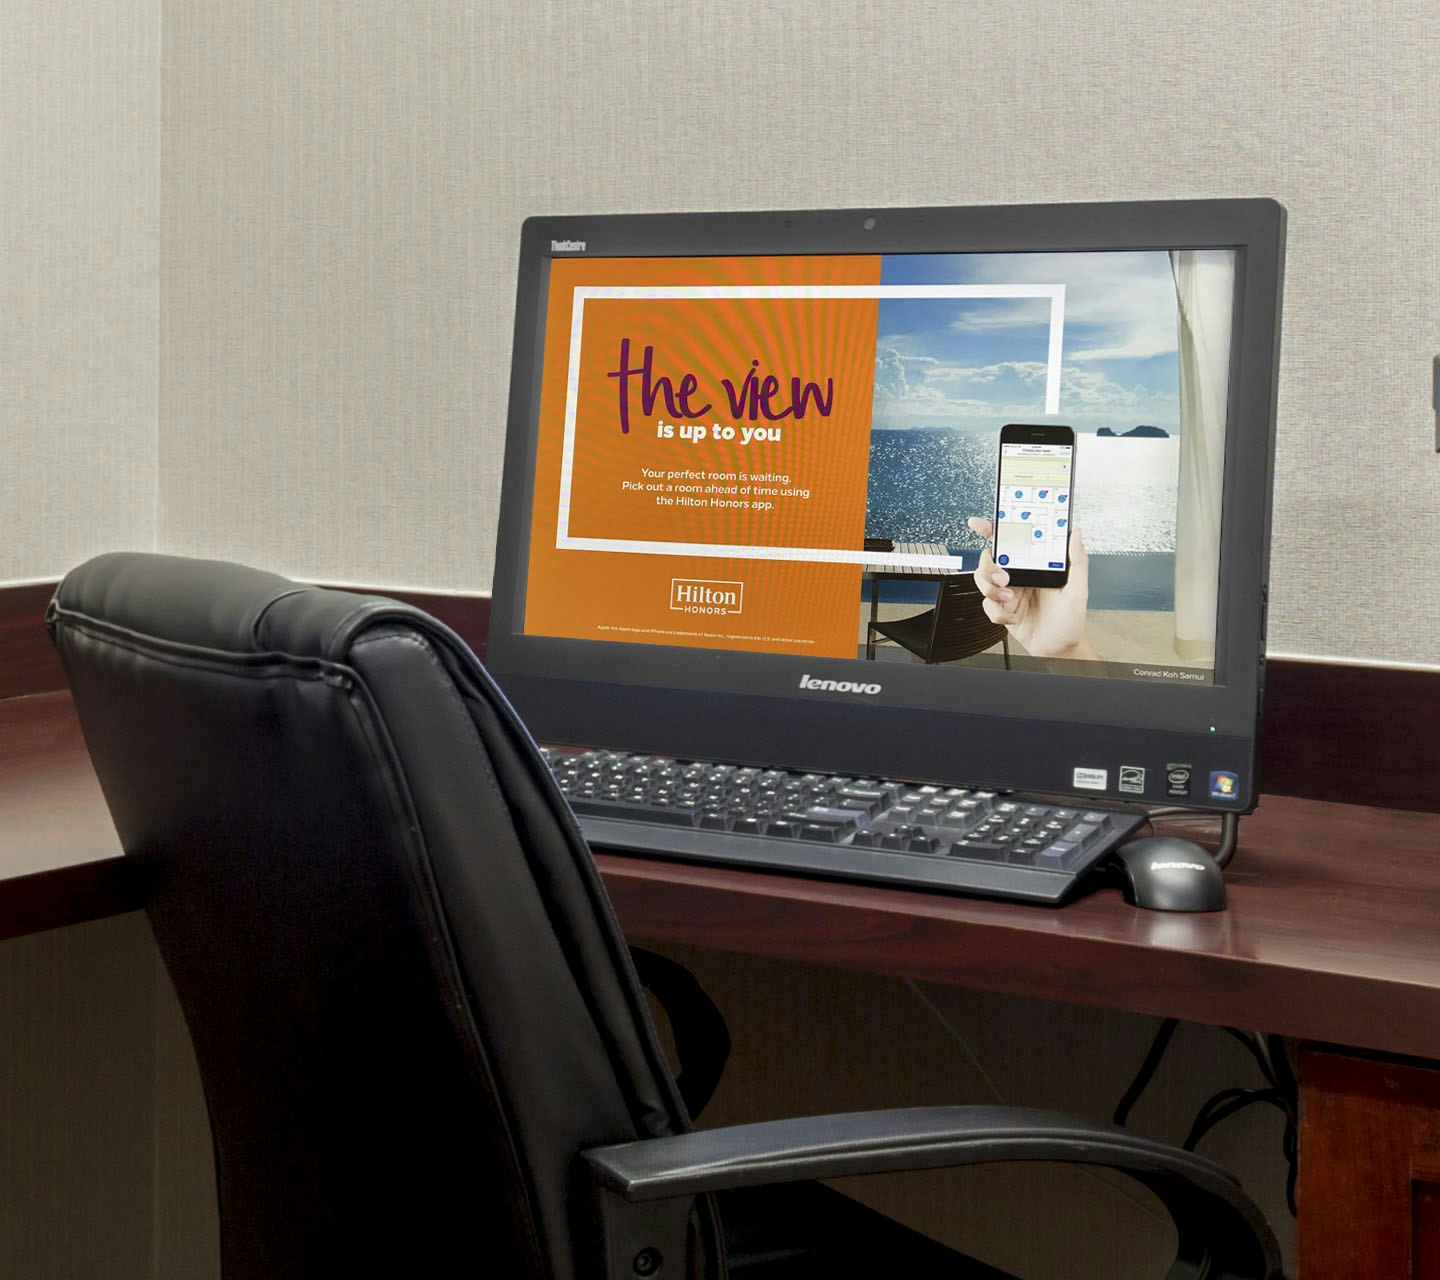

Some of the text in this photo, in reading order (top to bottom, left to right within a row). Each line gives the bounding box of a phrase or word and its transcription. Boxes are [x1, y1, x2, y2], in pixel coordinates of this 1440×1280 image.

[607, 337, 834, 435] the view
[657, 420, 782, 445] is up to you
[641, 468, 793, 485] Your perfect room is waiting.
[621, 481, 810, 500] Pick out a room ahead of time using
[656, 495, 775, 511] the Hilton Honors app.
[676, 584, 737, 606] Hilton
[683, 605, 728, 616] HONORS
[1132, 668, 1205, 681] Conrad Koh Samui
[798, 673, 882, 695] lenovo
[1150, 861, 1206, 871] lenovo
